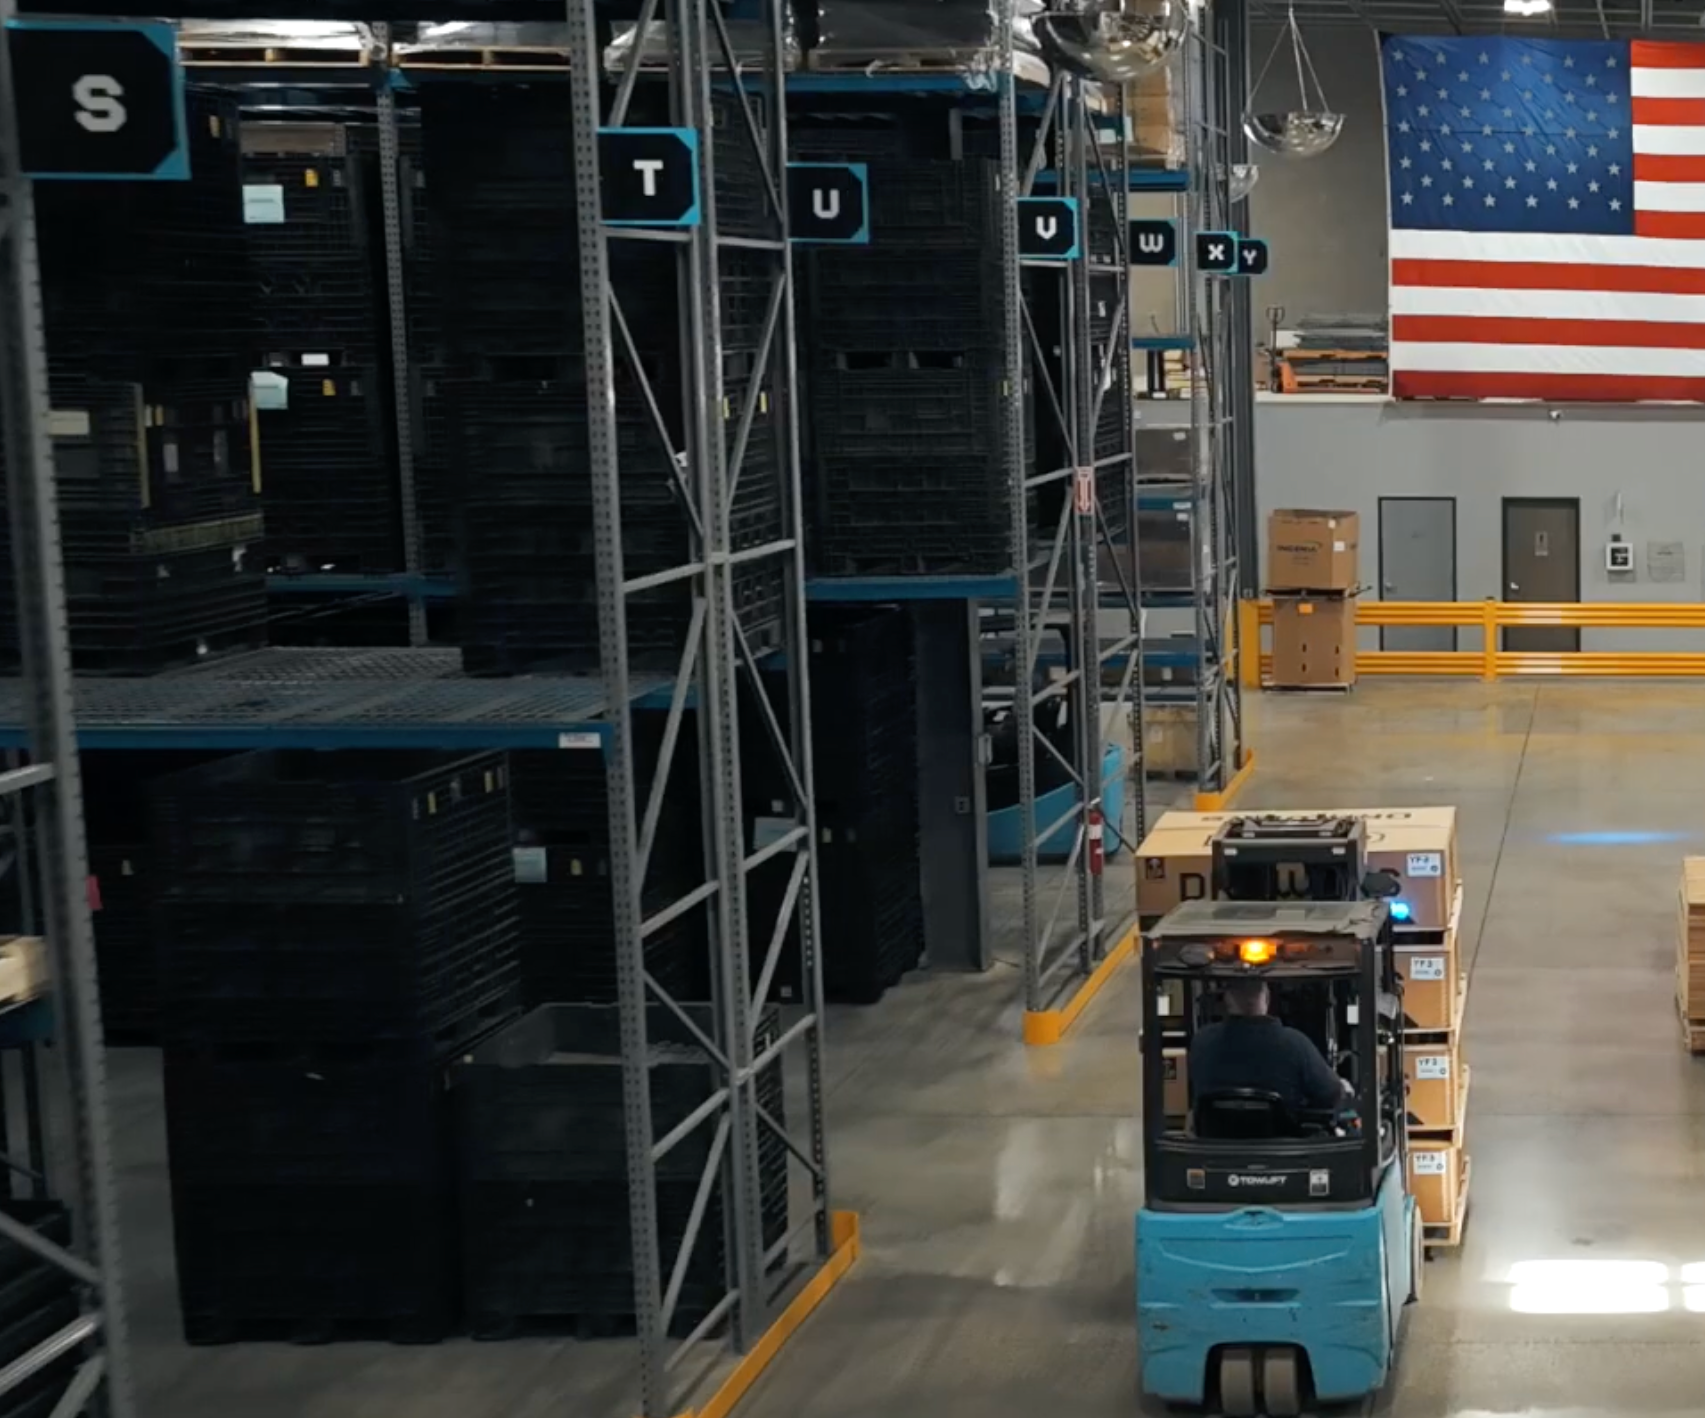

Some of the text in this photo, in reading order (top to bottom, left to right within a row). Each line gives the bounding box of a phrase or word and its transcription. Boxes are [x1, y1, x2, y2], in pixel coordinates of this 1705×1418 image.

[72, 74, 127, 132] S
[632, 160, 664, 196] T
[812, 189, 840, 219] U
[1035, 216, 1058, 240] V
[1139, 233, 1164, 253] W
[1208, 244, 1225, 260] X
[1243, 249, 1257, 265] Y
